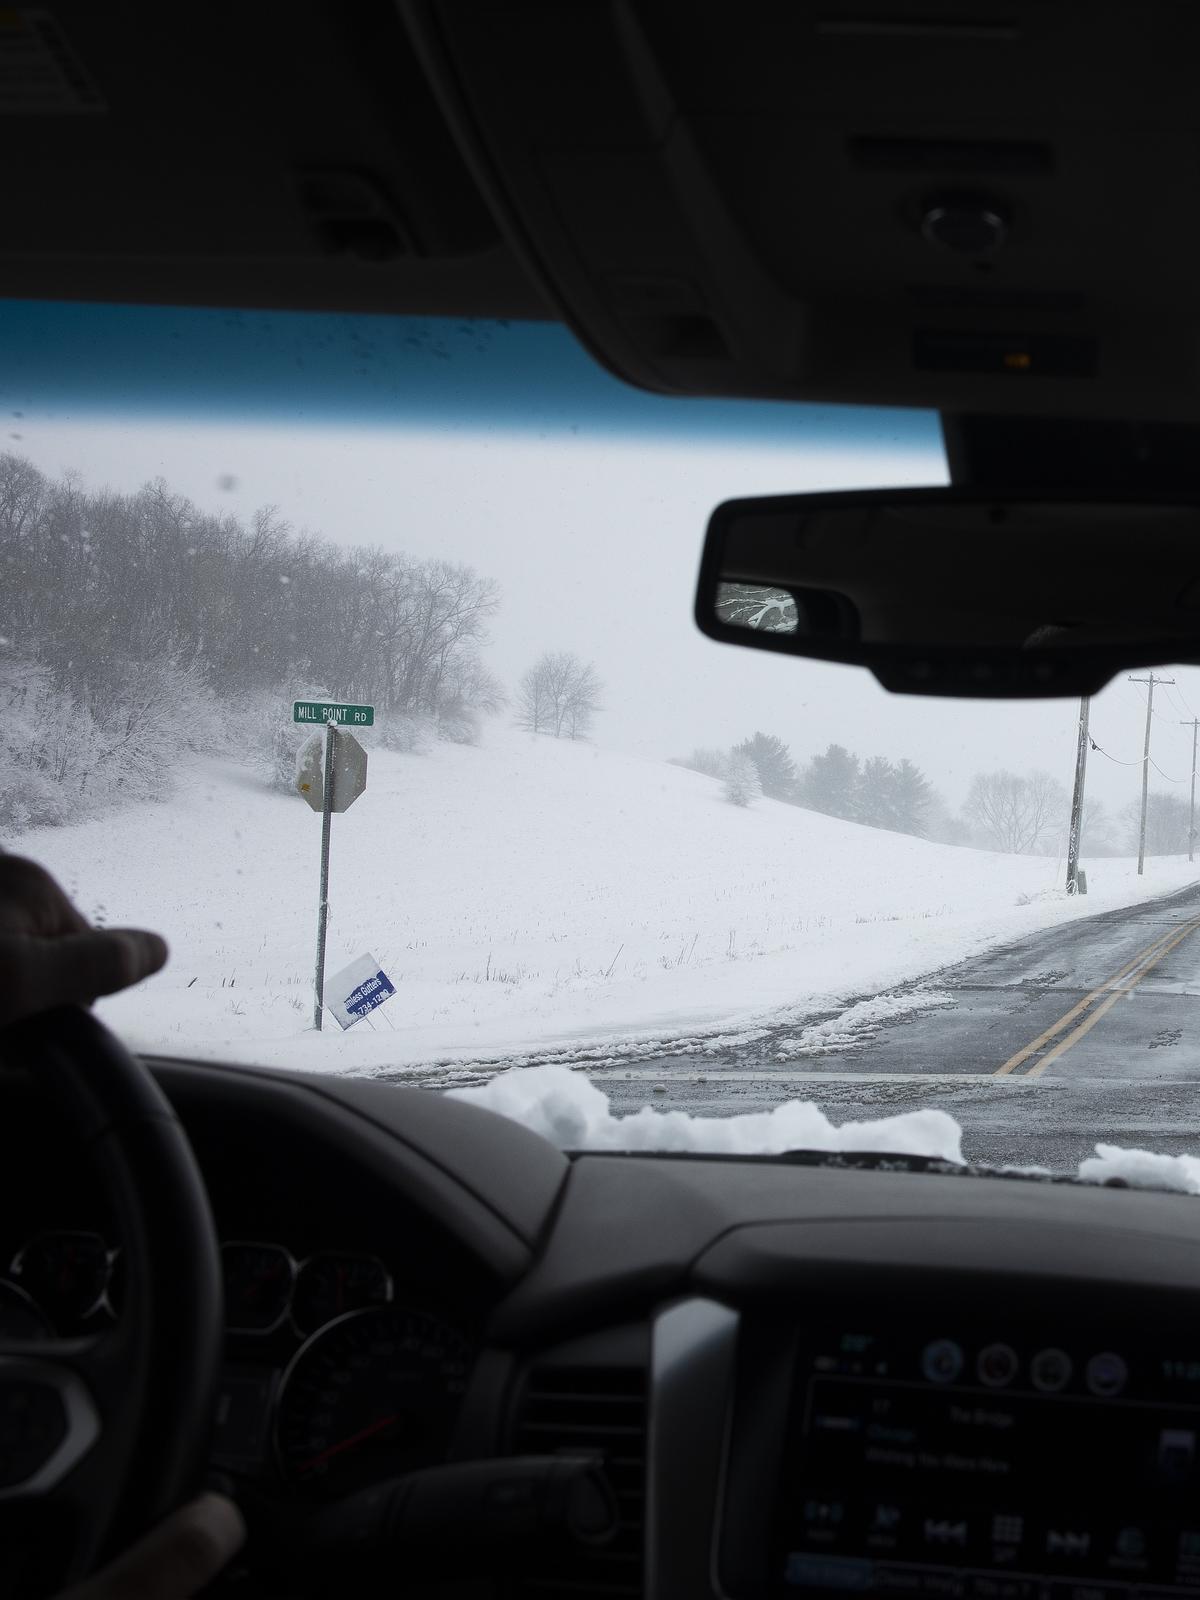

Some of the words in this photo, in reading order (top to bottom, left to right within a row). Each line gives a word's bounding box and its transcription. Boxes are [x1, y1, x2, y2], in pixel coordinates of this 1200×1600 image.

[298, 706, 317, 720] MILL
[322, 707, 348, 721] POINT
[354, 712, 367, 722] RD
[361, 979, 382, 995] Gutters
